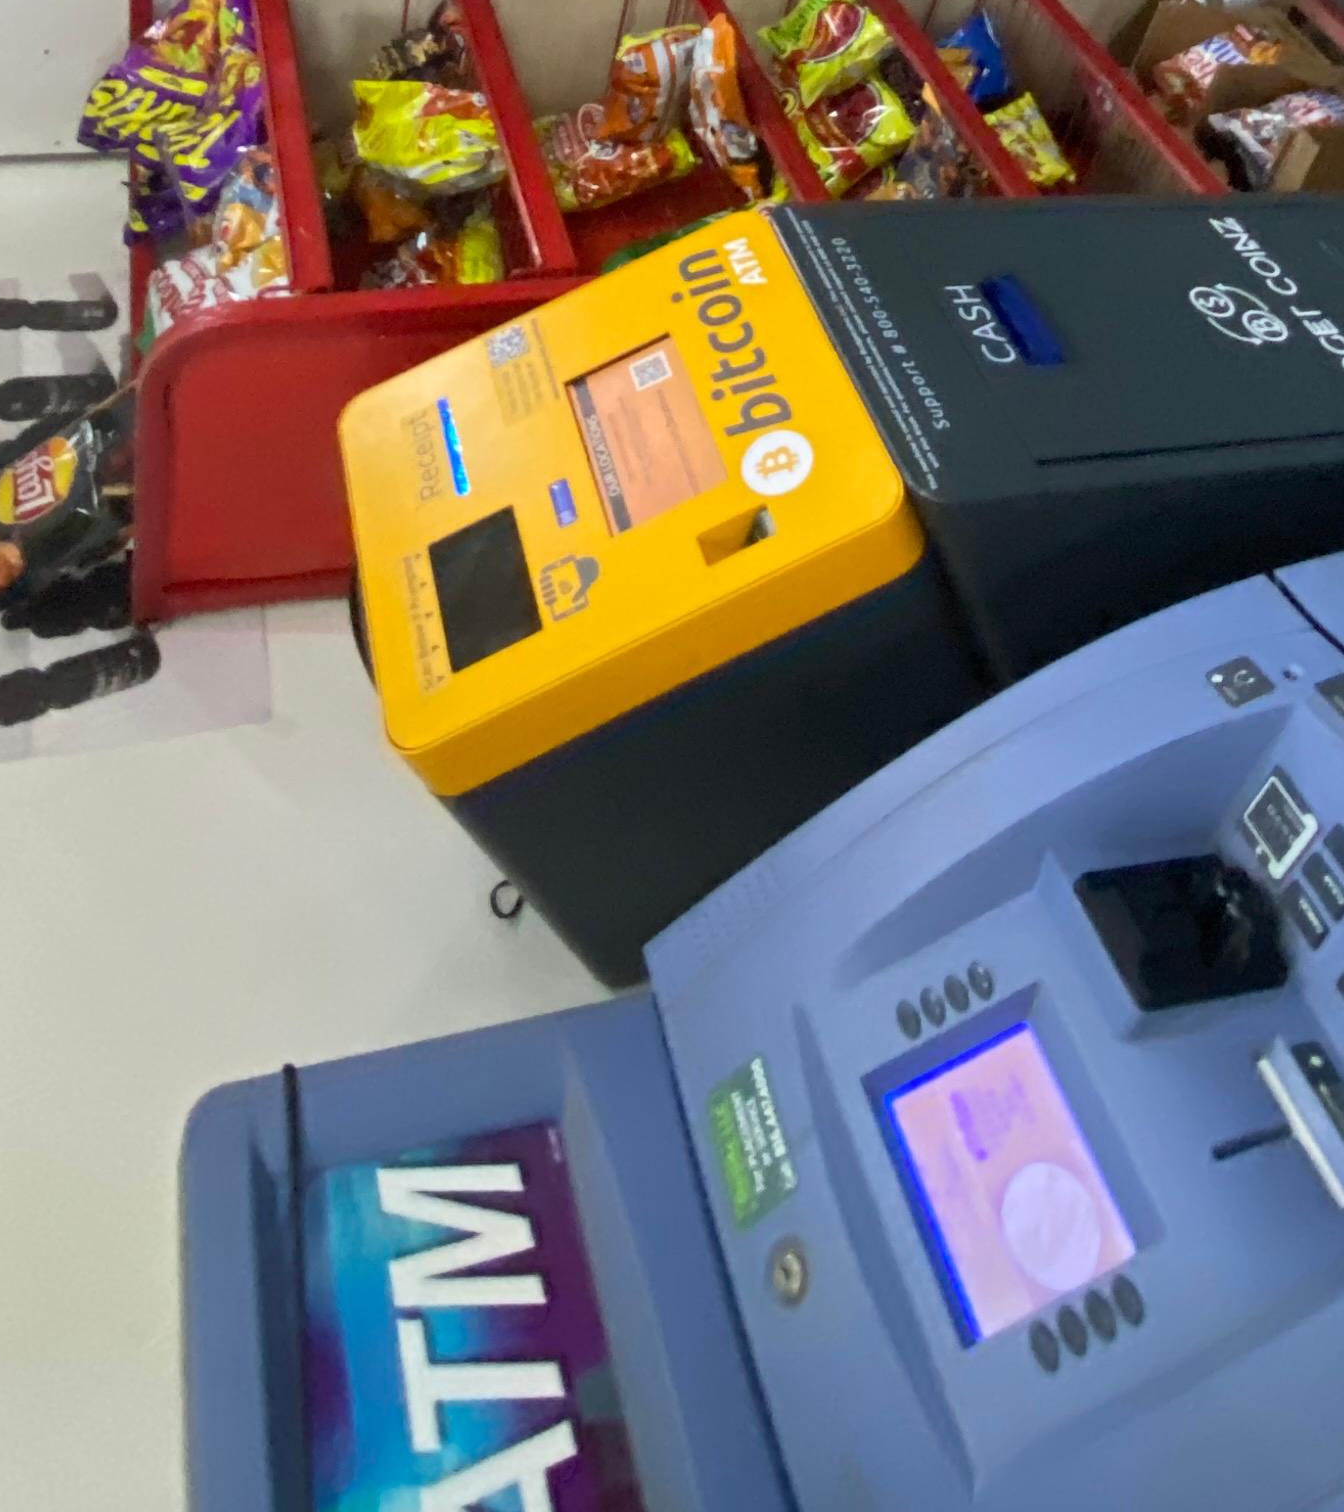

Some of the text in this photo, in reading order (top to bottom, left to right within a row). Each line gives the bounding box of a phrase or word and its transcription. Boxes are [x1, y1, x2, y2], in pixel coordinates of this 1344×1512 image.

[722, 236, 768, 285] ATM
[830, 235, 900, 340] 800-540-3220
[1209, 216, 1300, 297] COINZ
[670, 248, 793, 437] bitcoin
[944, 283, 1017, 364] CASH
[901, 360, 951, 430] Support
[401, 411, 441, 501] Receipt
[585, 413, 622, 497] OUR LOCATIONS
[376, 1162, 579, 1512] ATM
